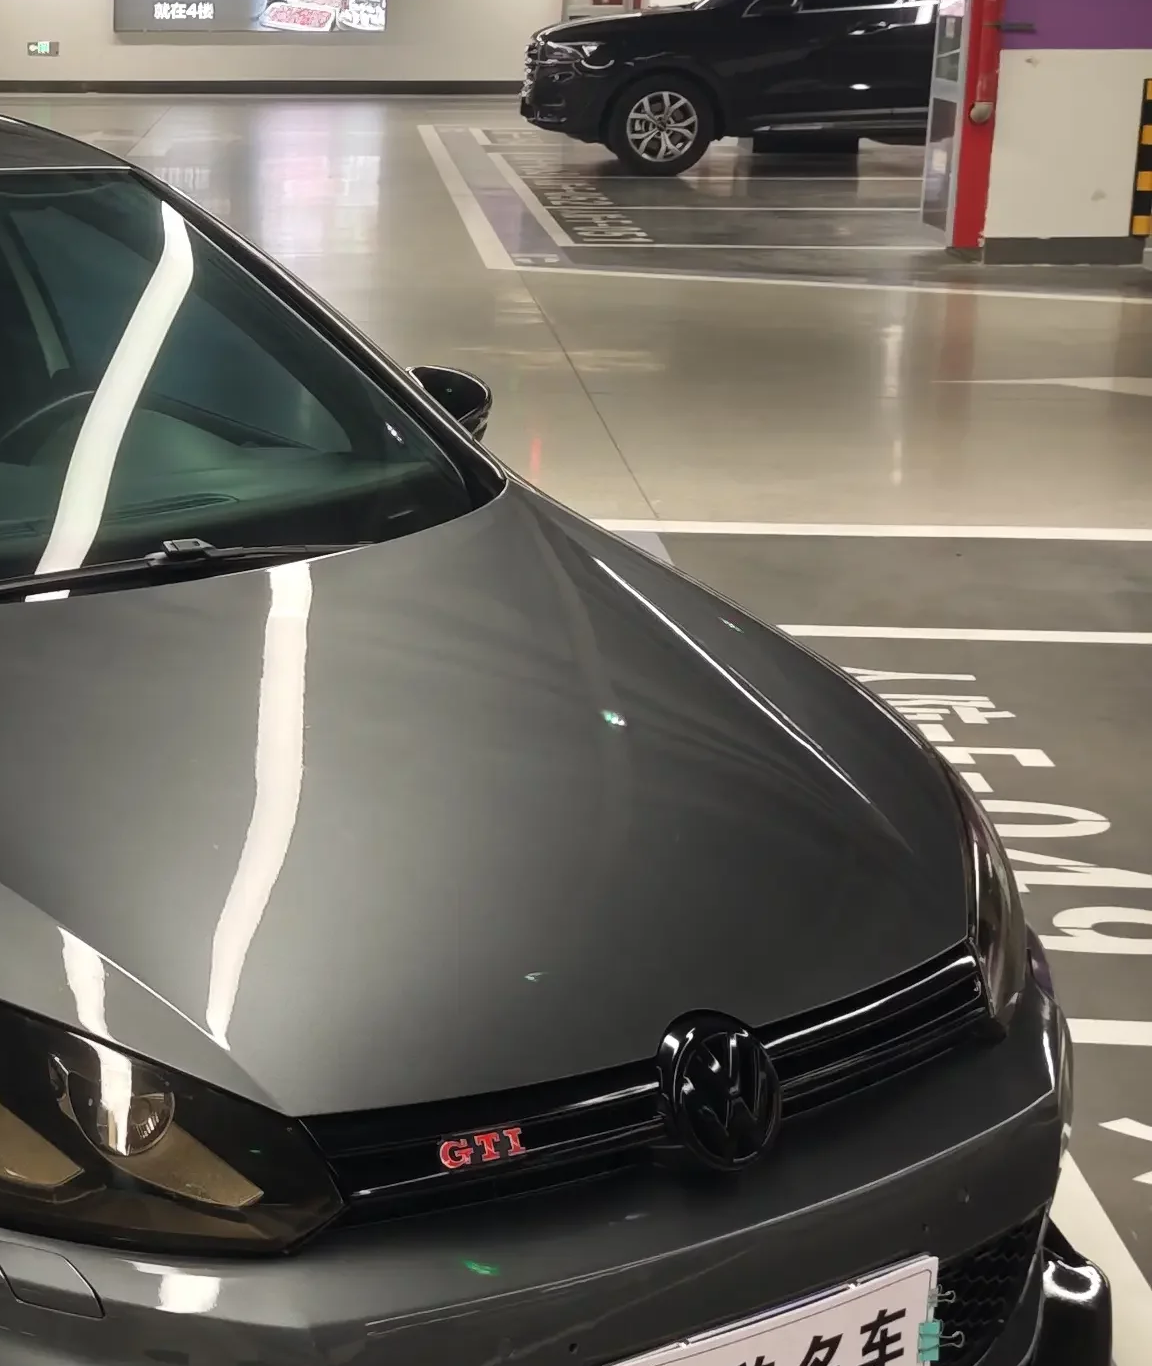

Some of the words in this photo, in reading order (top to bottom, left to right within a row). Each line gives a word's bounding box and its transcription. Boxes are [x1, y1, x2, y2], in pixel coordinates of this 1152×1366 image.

[153, 1, 214, 20] 就在4楼
[440, 1127, 526, 1169] GTI
